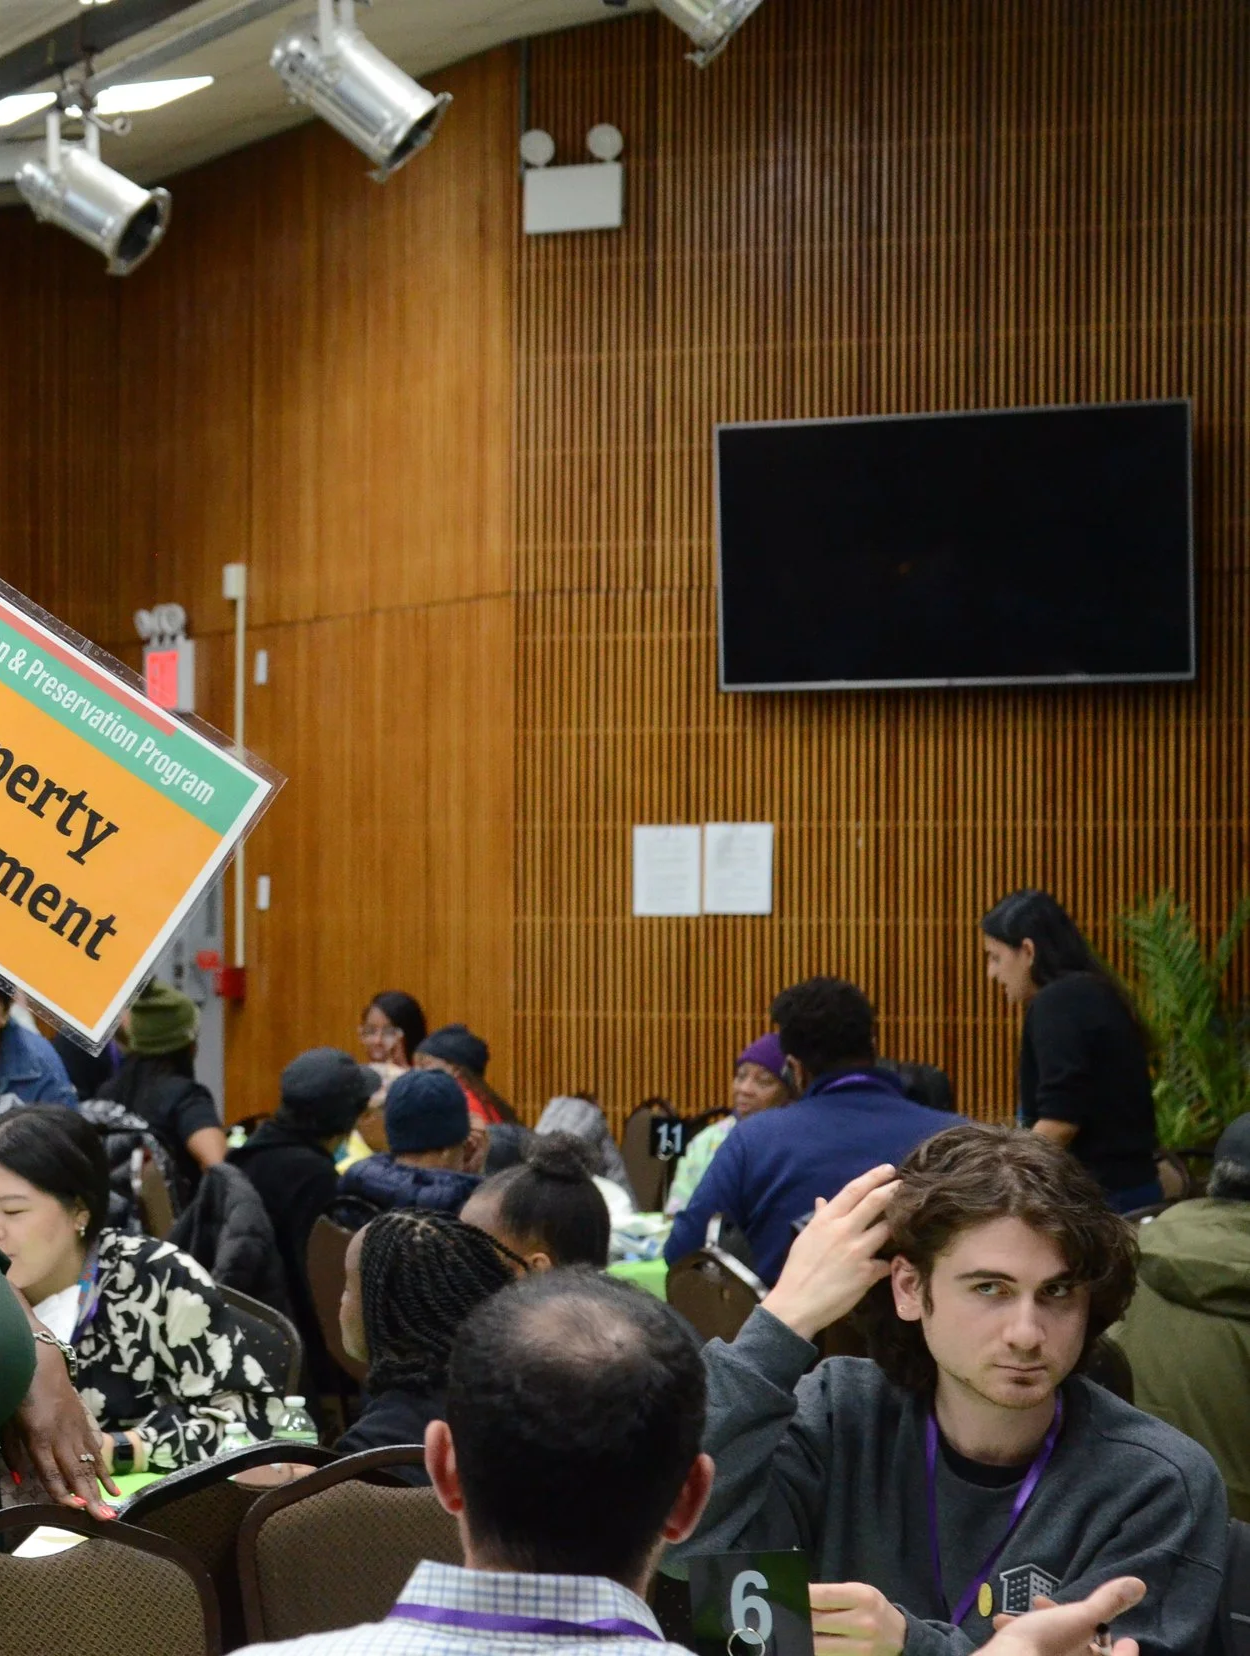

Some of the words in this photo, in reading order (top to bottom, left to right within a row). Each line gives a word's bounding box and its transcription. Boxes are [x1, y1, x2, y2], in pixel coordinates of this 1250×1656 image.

[7, 648, 27, 675] &
[23, 659, 139, 752] Preservation
[134, 736, 215, 805] Program
[656, 1122, 682, 1153] 11
[731, 1570, 772, 1645] 6
